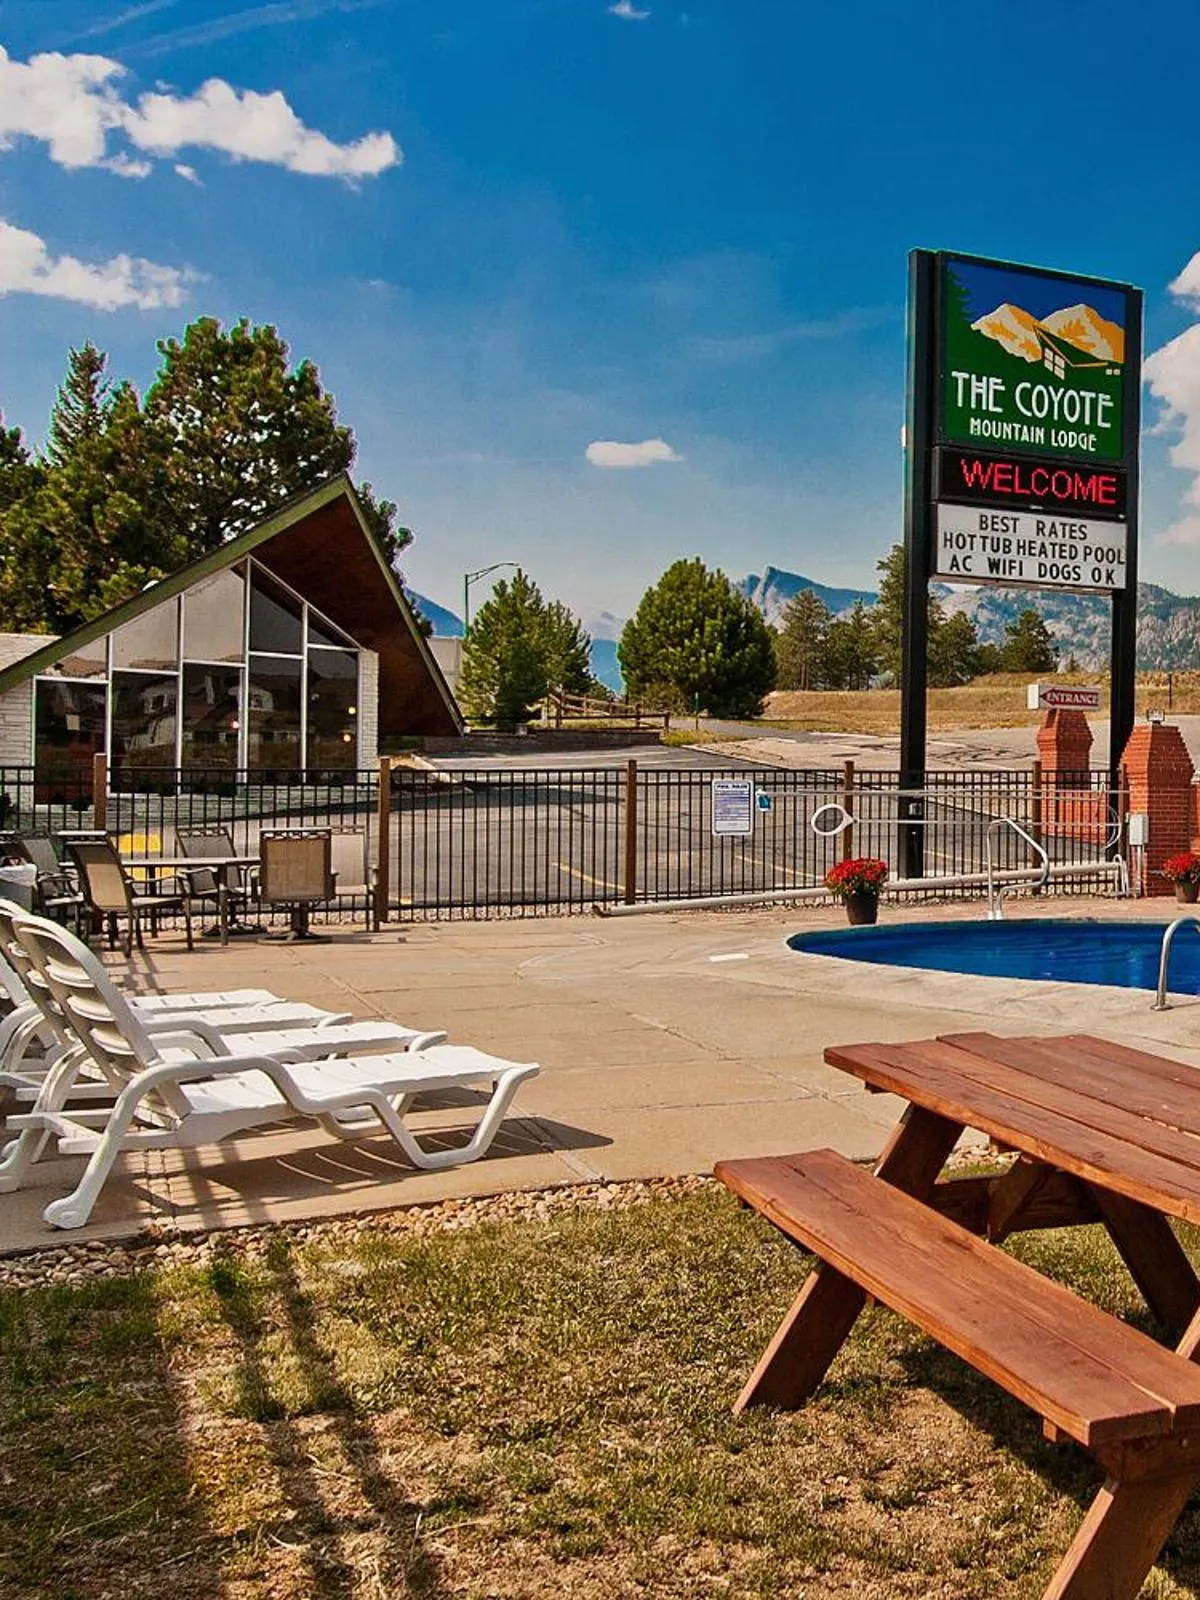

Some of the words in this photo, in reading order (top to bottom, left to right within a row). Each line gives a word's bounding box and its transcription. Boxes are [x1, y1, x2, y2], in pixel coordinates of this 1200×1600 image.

[951, 370, 1006, 413] THE
[1015, 382, 1114, 428] COYOTE
[969, 417, 1045, 445] MOUNTAIN
[1051, 428, 1097, 452] LODGE
[960, 458, 1117, 504] WELCOME
[979, 514, 1020, 534] BEST
[1036, 520, 1088, 541] RATES
[943, 532, 977, 551] HOT
[980, 535, 1012, 555] TUB
[1017, 539, 1078, 561] HEATED
[1083, 545, 1125, 565] POOL
[950, 554, 973, 572] AC
[987, 556, 1023, 577] WIFI
[1038, 562, 1081, 582] DOGS
[1091, 567, 1116, 585] OK
[1046, 692, 1097, 705] ENTRANCE
